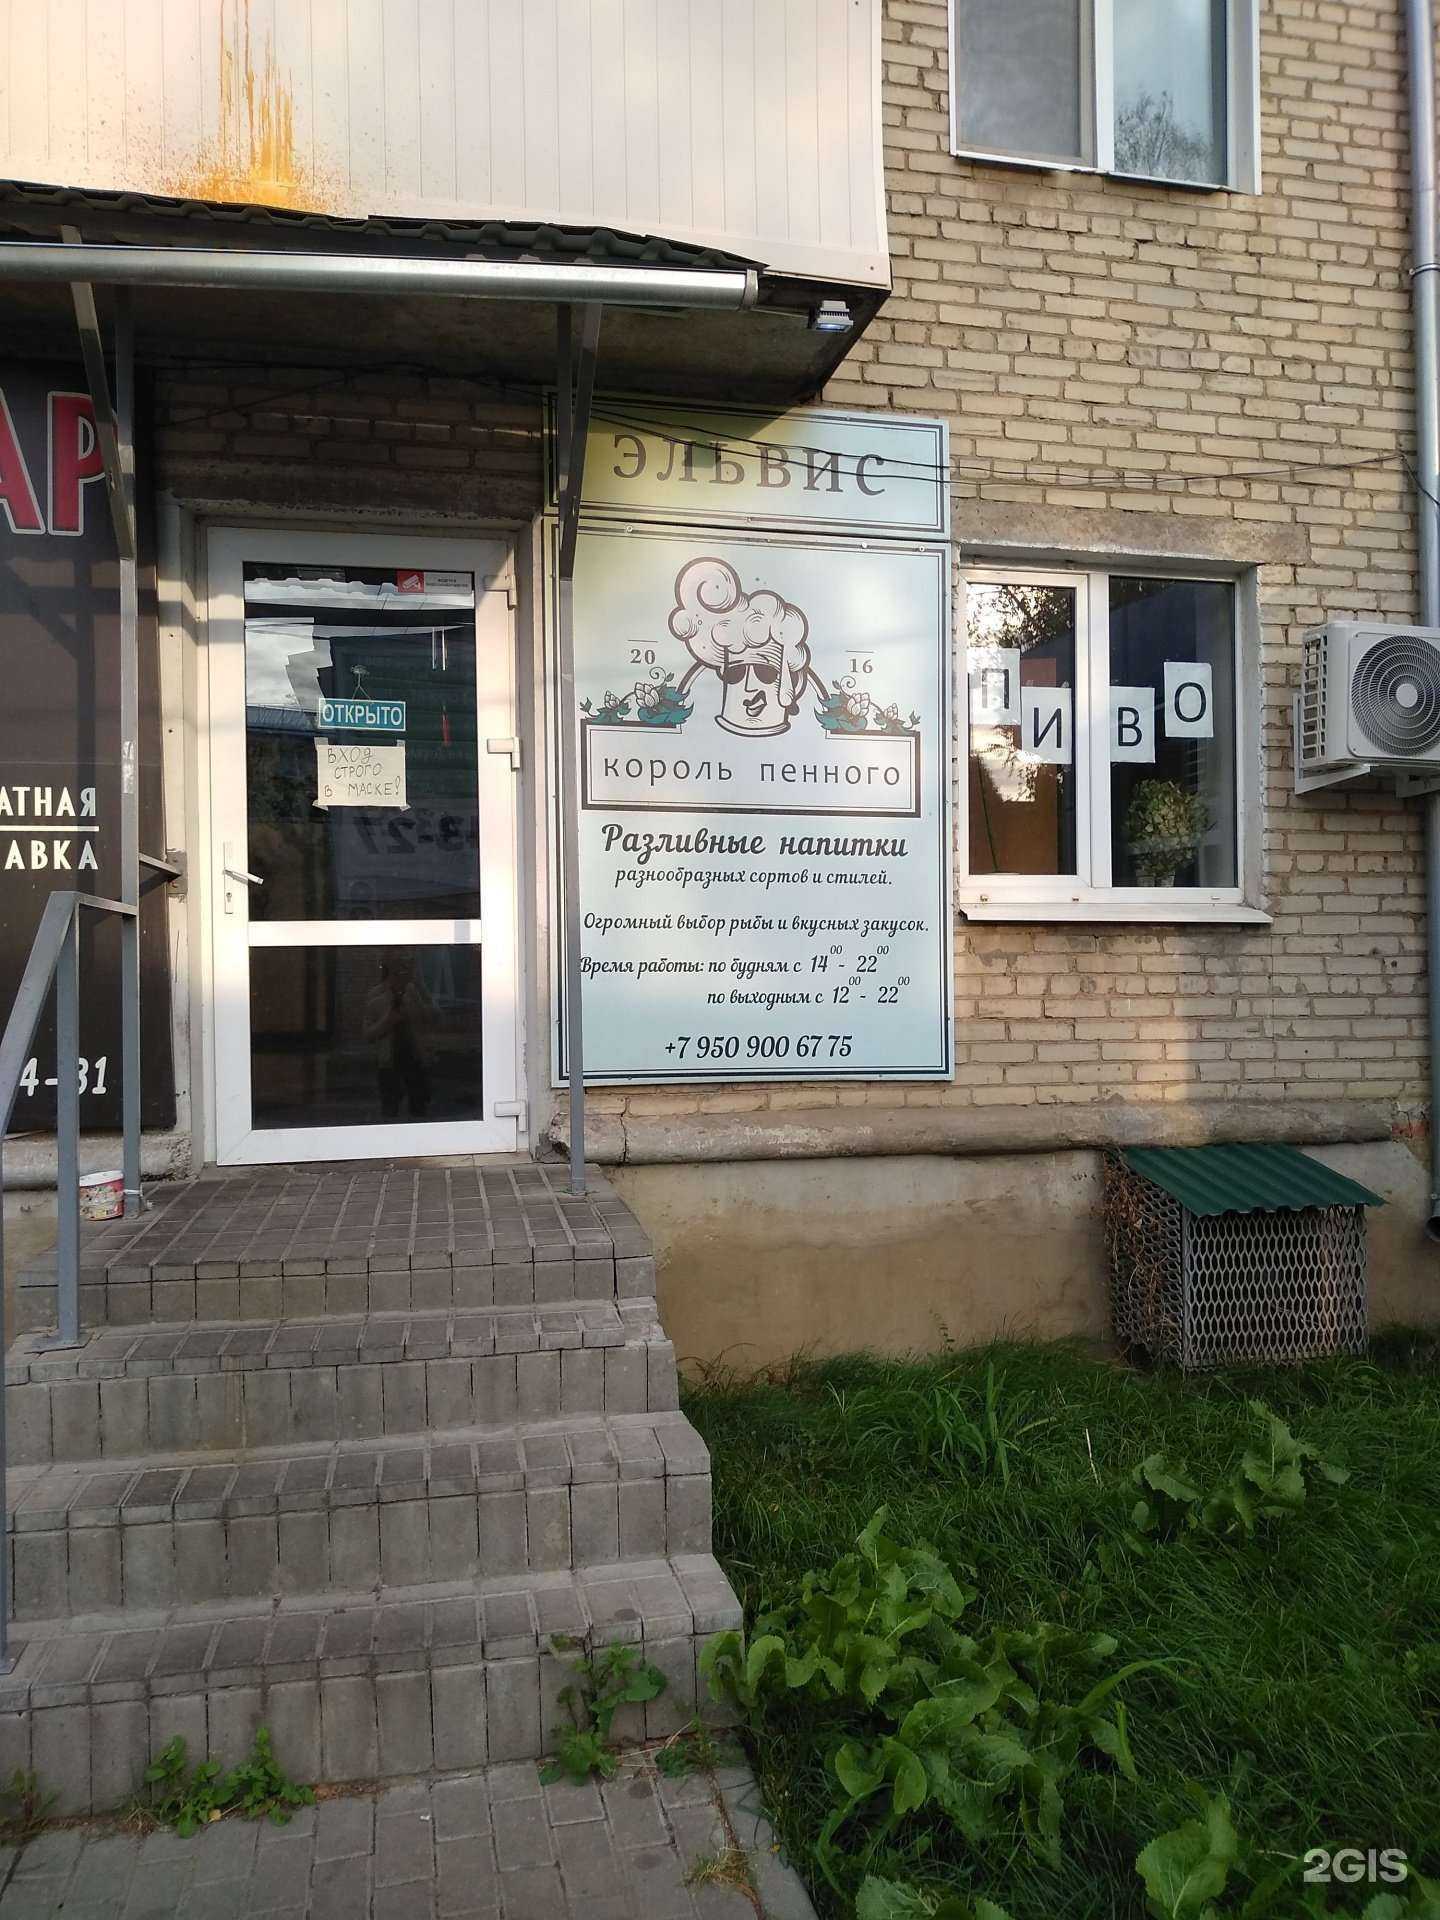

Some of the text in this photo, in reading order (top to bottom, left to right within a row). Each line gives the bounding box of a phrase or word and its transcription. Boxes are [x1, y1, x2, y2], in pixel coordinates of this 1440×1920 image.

[613, 434, 886, 496] ЭЛЬВИС
[630, 648, 656, 665] 20
[850, 658, 873, 674] 16
[322, 703, 402, 726] ОТКРЫТО
[334, 763, 383, 779] СТРОГО
[604, 758, 900, 786] король пенного
[324, 776, 401, 798] В МАСКЕ!
[601, 823, 909, 866] Разливные напитки
[615, 867, 893, 890] разнообразных сортов и стилей.
[584, 912, 929, 938] Огромный выбор рыбы и вкусных закусок.
[580, 957, 634, 980] Время
[637, 958, 704, 980] работы:
[708, 961, 726, 973] по
[730, 958, 789, 980] будням
[793, 962, 802, 973] с
[707, 993, 725, 1004] по
[730, 989, 811, 1010] выходным
[815, 993, 824, 1004] с
[665, 1035, 853, 1058] +7 950 900 67 75
